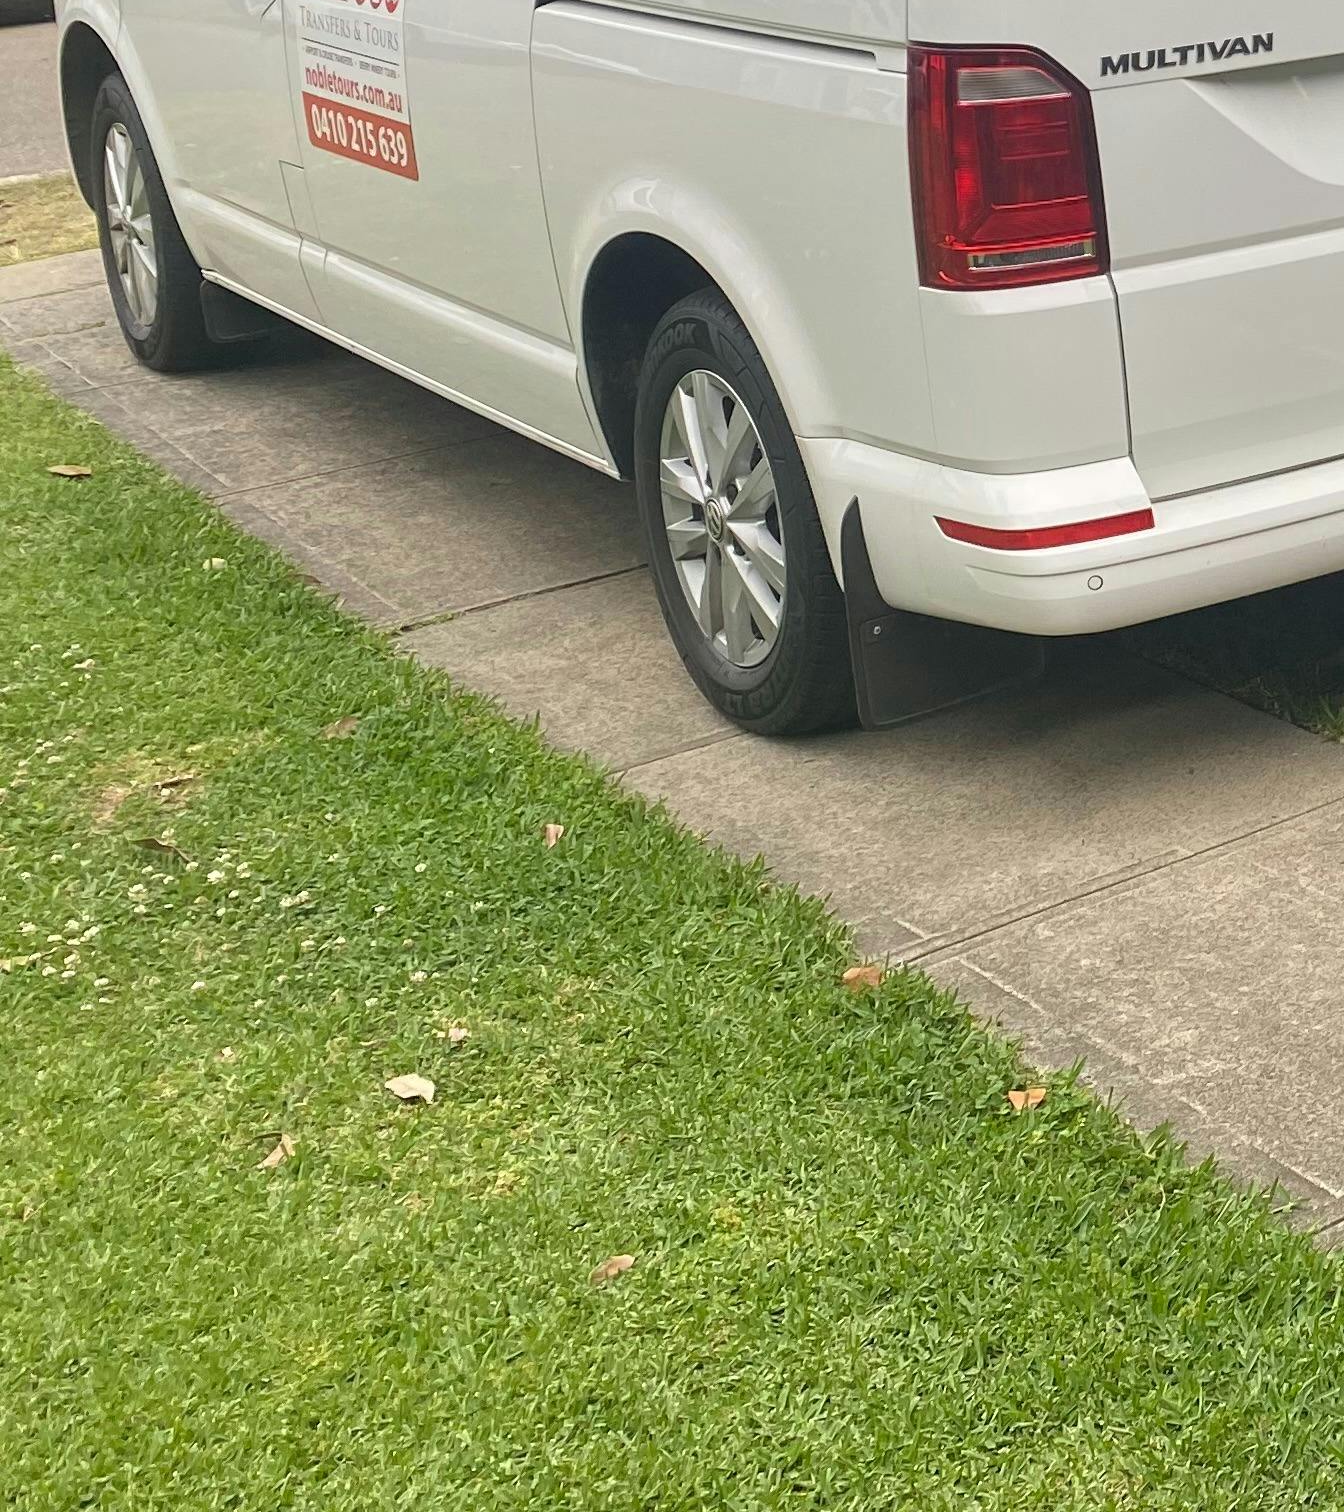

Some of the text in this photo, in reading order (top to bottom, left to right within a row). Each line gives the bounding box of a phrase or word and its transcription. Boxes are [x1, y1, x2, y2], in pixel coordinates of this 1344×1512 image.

[299, 5, 399, 52] TRANSFERS & TOURS
[1100, 32, 1273, 76] MULTIVAN
[304, 62, 403, 114] nobletours.com.au
[311, 103, 408, 168] 0410 215 639
